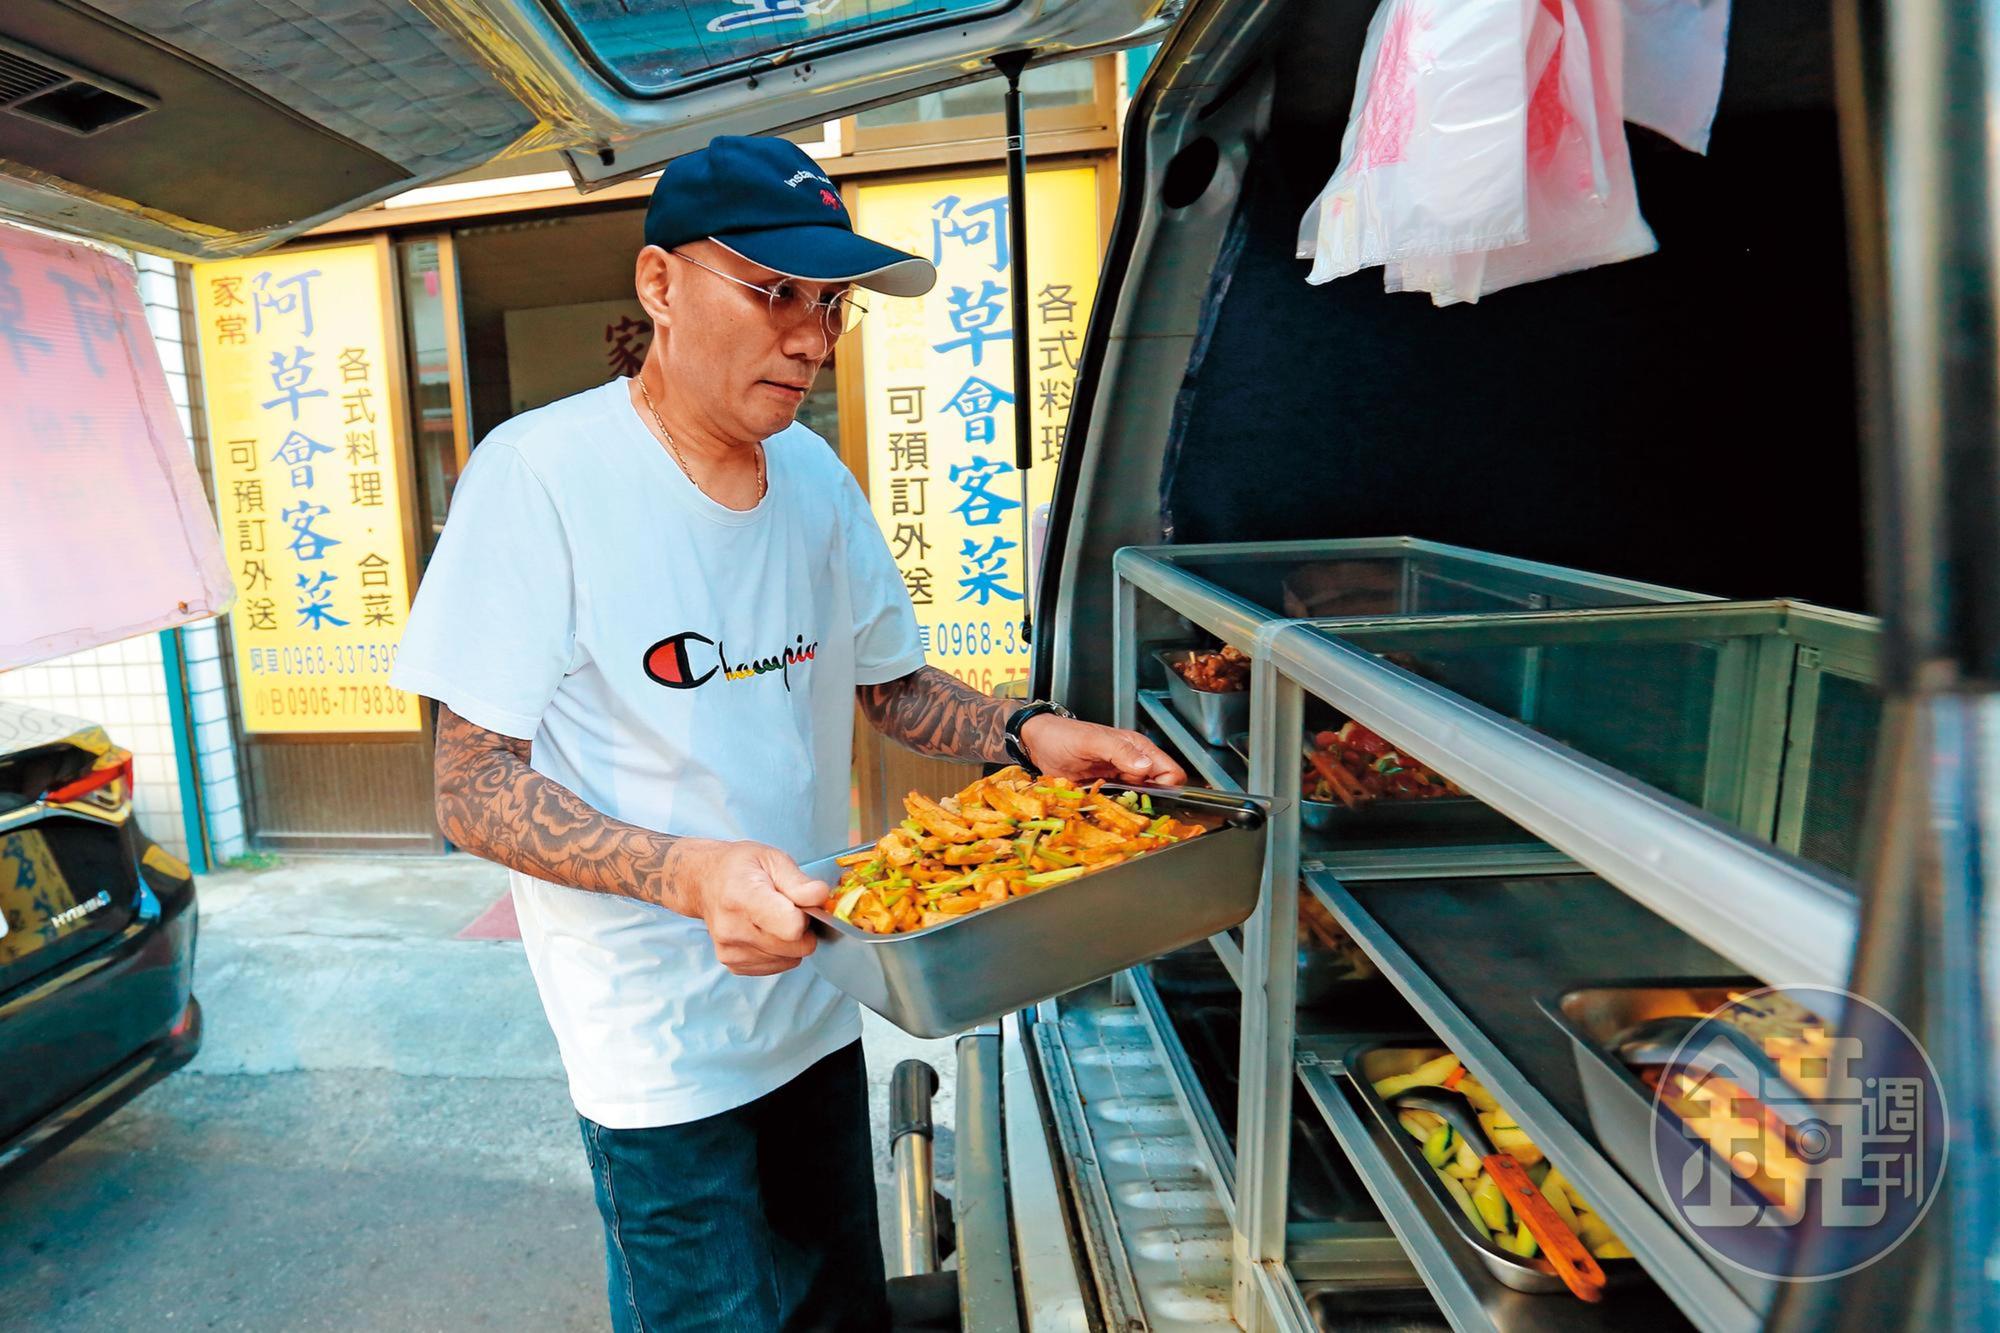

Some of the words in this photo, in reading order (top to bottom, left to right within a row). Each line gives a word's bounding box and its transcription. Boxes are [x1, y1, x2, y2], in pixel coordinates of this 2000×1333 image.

[211, 276, 248, 345] 家常
[931, 194, 1025, 606] 阿草會客菜
[227, 438, 278, 632] 可預訂外送
[251, 269, 350, 632] 阿草會客菜
[886, 385, 934, 605] 可預訂外送
